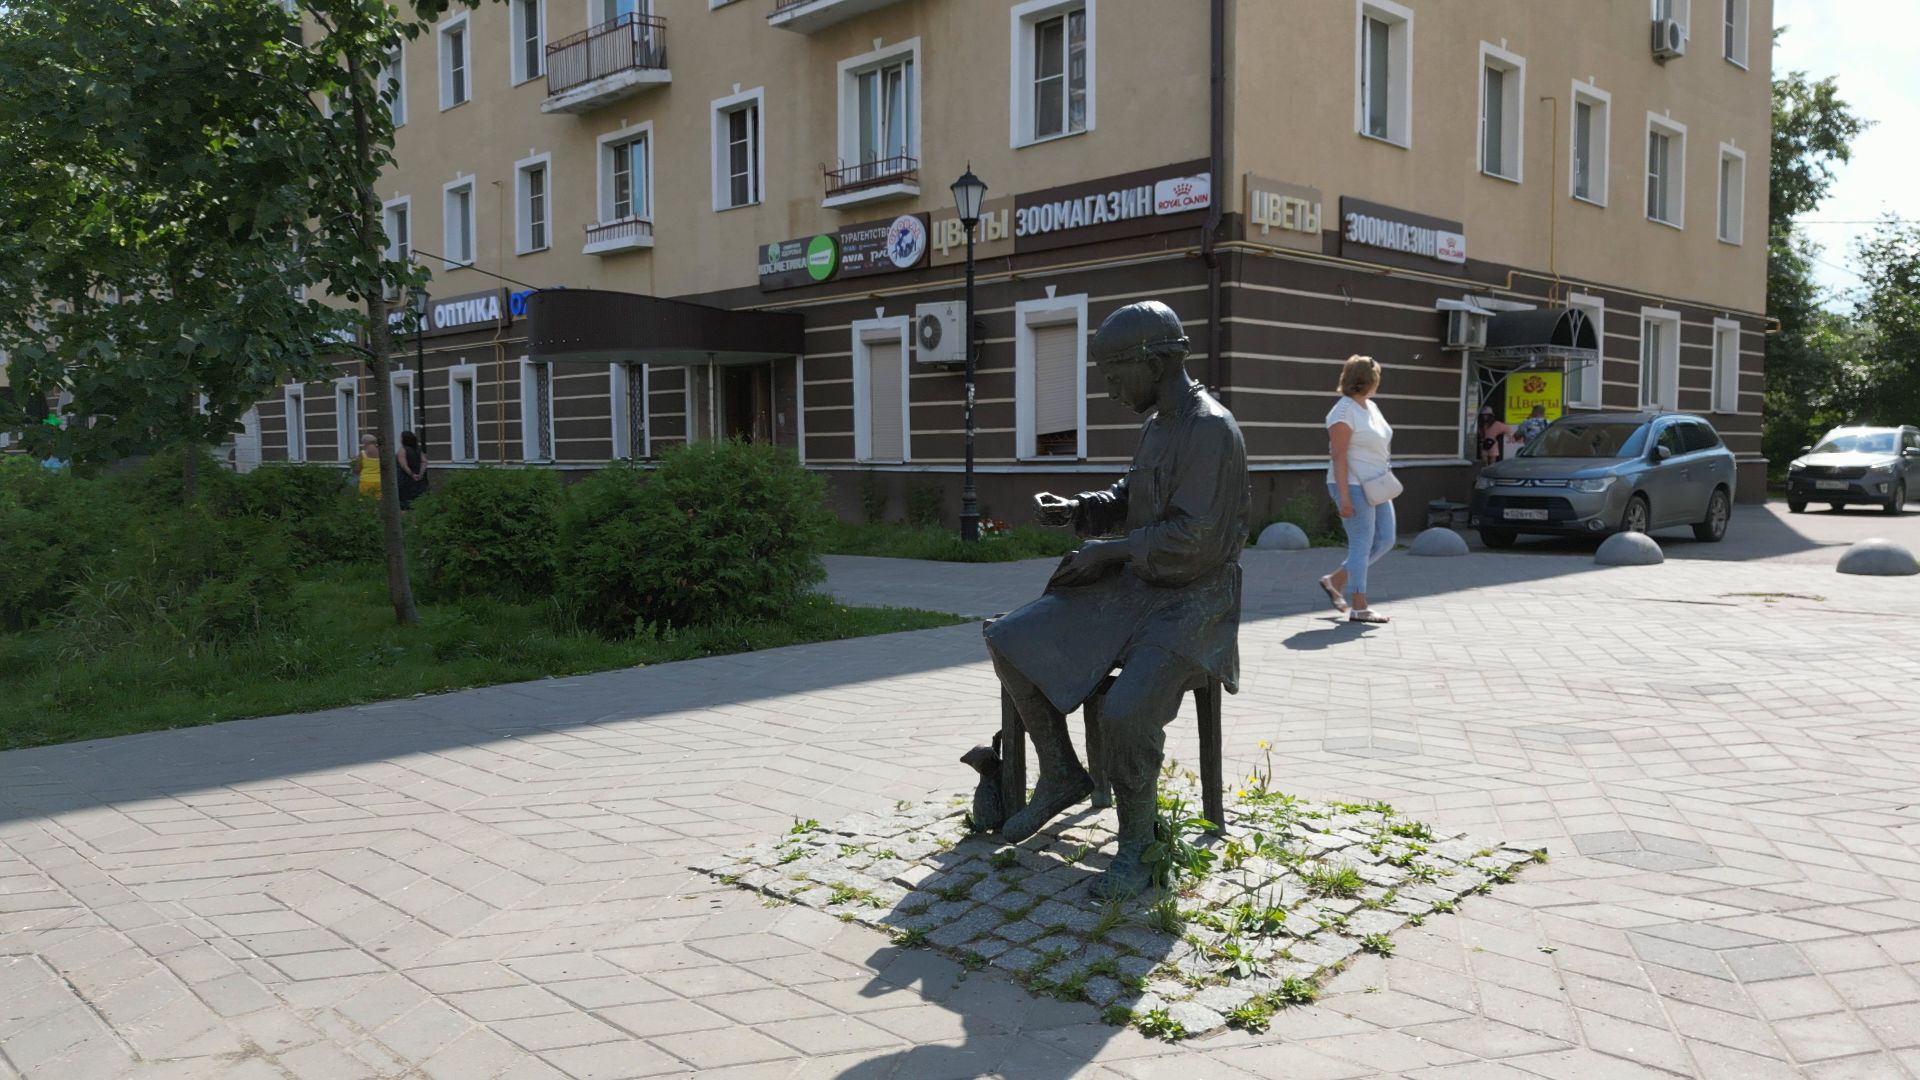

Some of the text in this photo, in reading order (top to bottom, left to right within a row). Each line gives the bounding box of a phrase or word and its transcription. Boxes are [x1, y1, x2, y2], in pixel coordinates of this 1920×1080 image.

[1016, 185, 1153, 237] ЗООМАГАЗИН
[1158, 194, 1209, 210] ROYAL CANIN
[1251, 190, 1321, 235] ЦВЕТЫ
[840, 226, 891, 244] ТУРАГЕНТСТВО
[1345, 212, 1435, 257] ЗООМАГАЗИН
[434, 296, 503, 328] ОПТИКА
